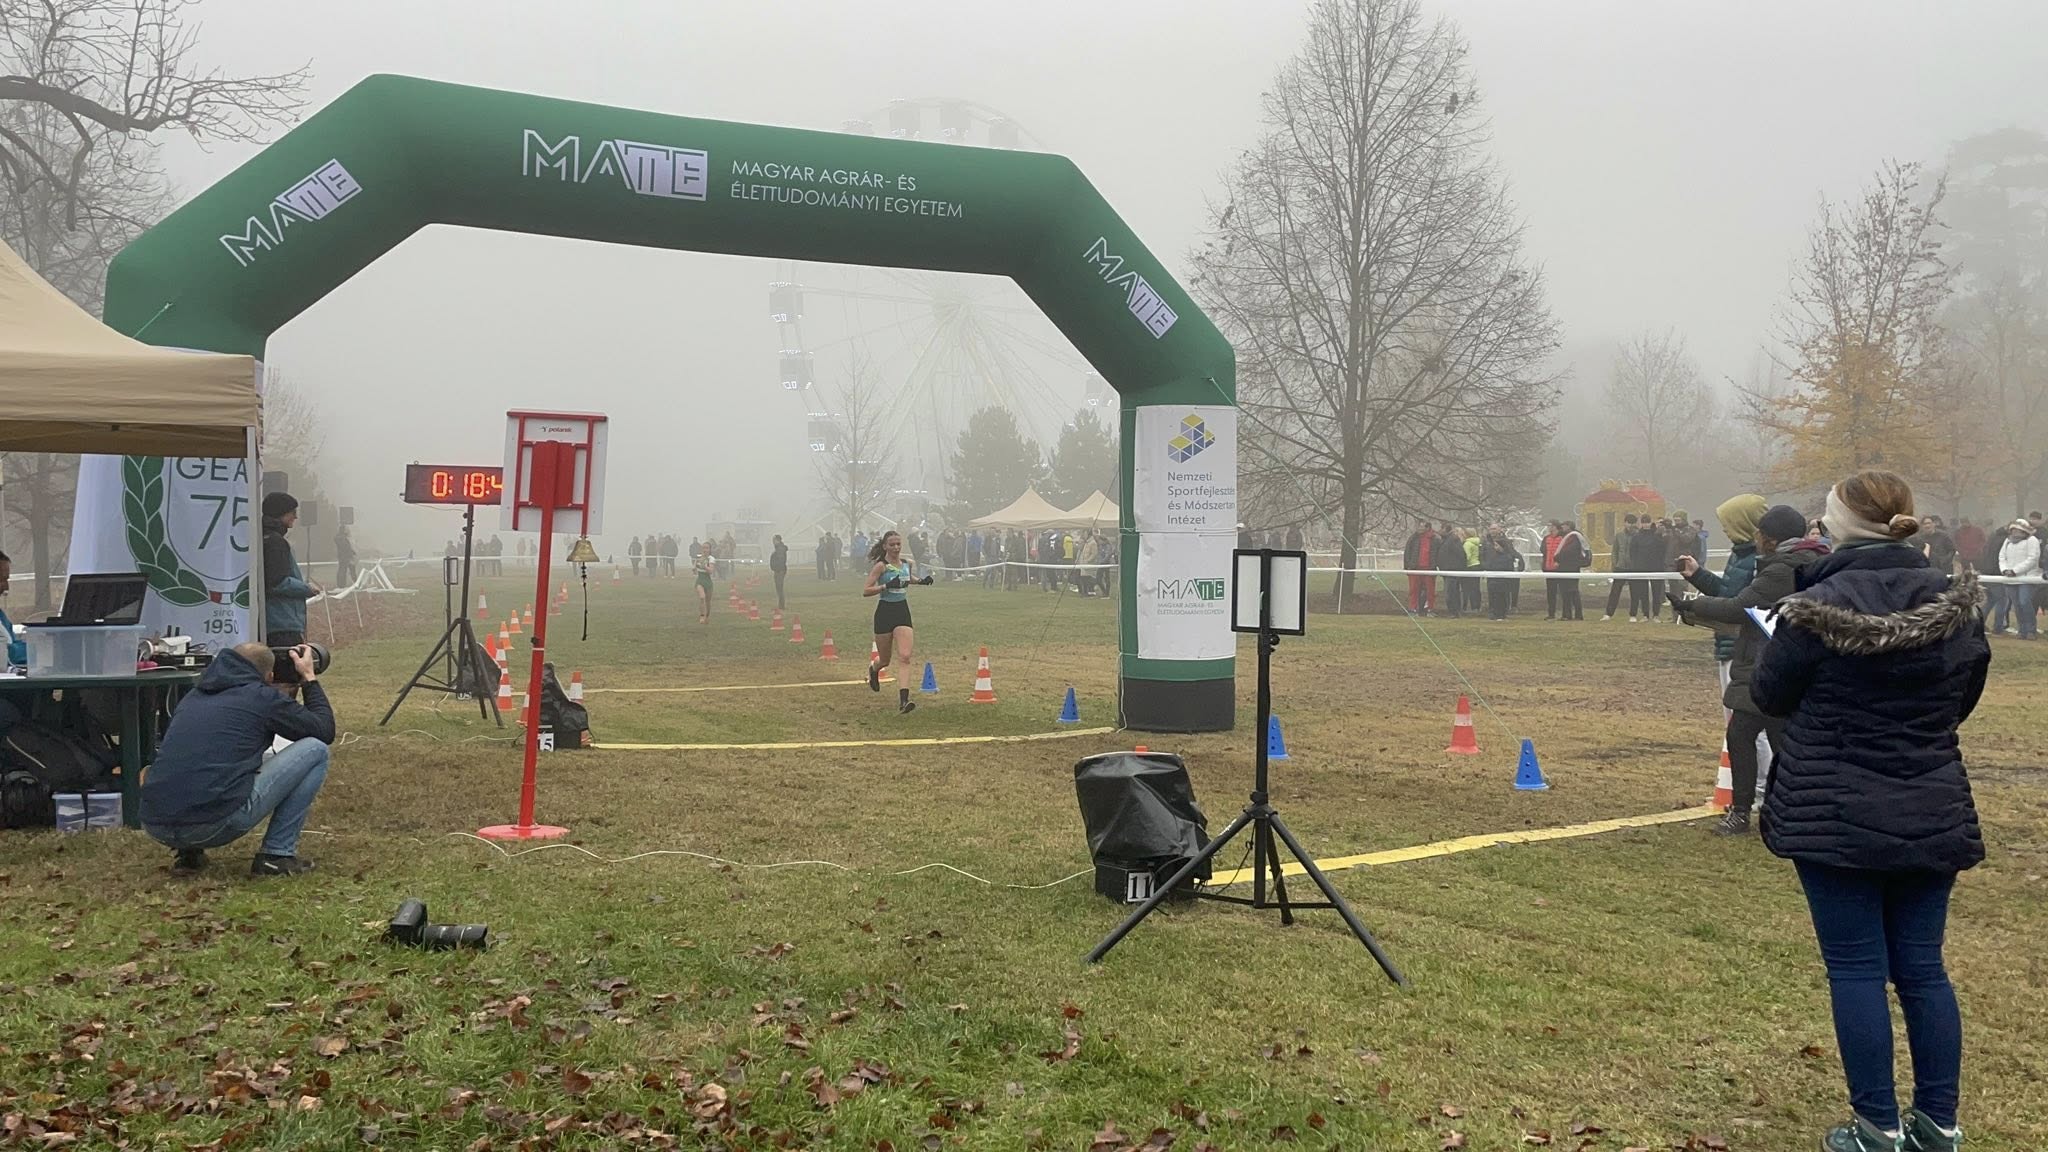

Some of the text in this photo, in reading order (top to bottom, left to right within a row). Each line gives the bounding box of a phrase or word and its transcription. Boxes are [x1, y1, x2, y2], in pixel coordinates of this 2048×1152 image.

[523, 129, 708, 201] MATE
[732, 160, 916, 191] MAGYAR AGRÁR- ÉS
[219, 158, 363, 267] MATE
[731, 181, 962, 218] ÉLETTUDOMÁNYI EGYETEM
[1083, 236, 1179, 339] MATE
[1168, 472, 1212, 481] Nemzeti
[1168, 500, 1181, 510] és
[1168, 515, 1206, 524] Intézet
[190, 494, 249, 552] 75
[1158, 577, 1224, 601] MATE
